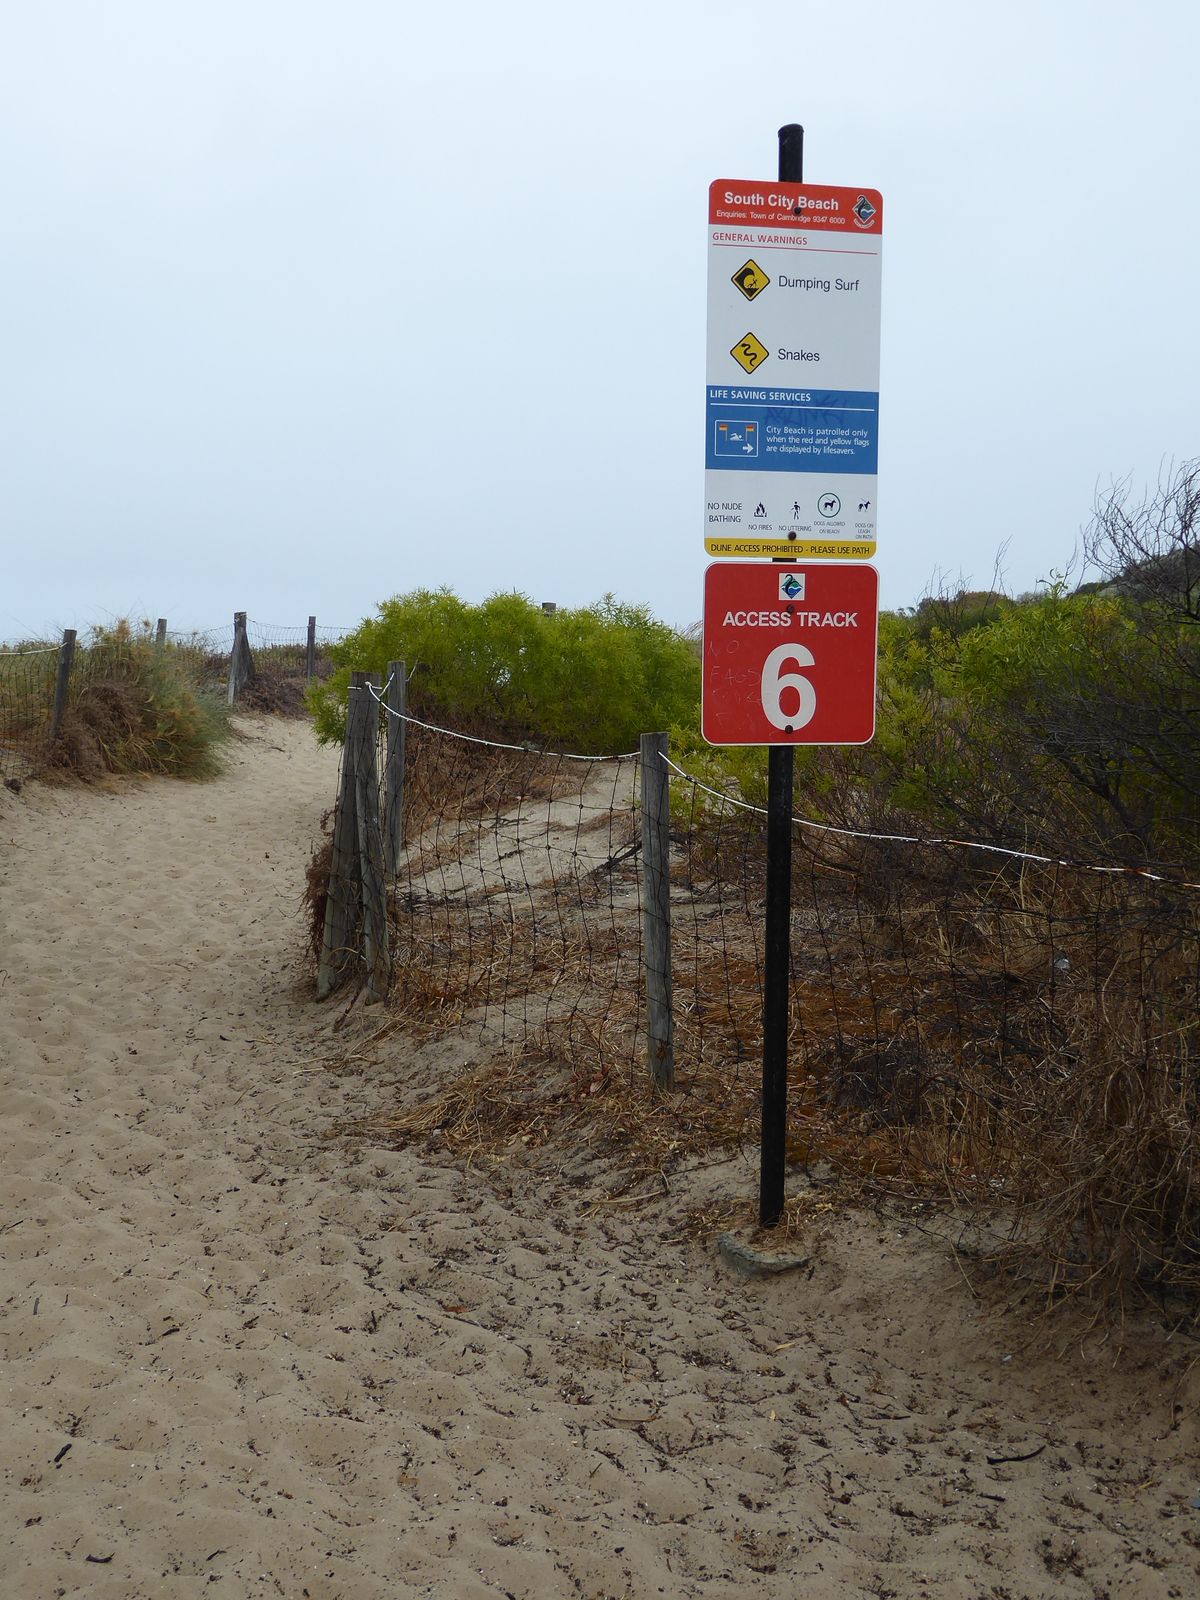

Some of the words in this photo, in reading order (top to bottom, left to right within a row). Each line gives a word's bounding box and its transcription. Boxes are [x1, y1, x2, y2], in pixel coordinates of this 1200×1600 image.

[724, 192, 765, 206] South
[768, 194, 794, 210] City
[798, 197, 838, 210] Beach
[716, 210, 747, 219] Enquiries:
[777, 213, 810, 222] Cambridge
[813, 215, 827, 223] 9347
[713, 233, 754, 242] GENERAL
[757, 235, 807, 245] WARNINGS
[779, 276, 830, 292] Dumping
[835, 279, 859, 291] Surf
[778, 349, 820, 361] Snakes
[710, 390, 728, 398] LIFE
[731, 391, 766, 400] SAVING
[769, 392, 811, 401] SERVICES
[766, 426, 781, 434] City
[784, 426, 805, 434] Beach
[816, 428, 849, 437] patrolled
[852, 430, 868, 438] only
[788, 436, 800, 444] the
[802, 436, 813, 444] red
[830, 438, 851, 446] yellow
[854, 438, 869, 446] flags
[779, 445, 811, 454] displayed
[813, 447, 821, 455] by
[709, 515, 741, 523] BATHING
[735, 544, 760, 552] ACCESS
[762, 545, 803, 553] PROHIBITED
[723, 612, 791, 626] ACCESS
[797, 612, 858, 627] TRACK
[761, 643, 816, 731] 6
